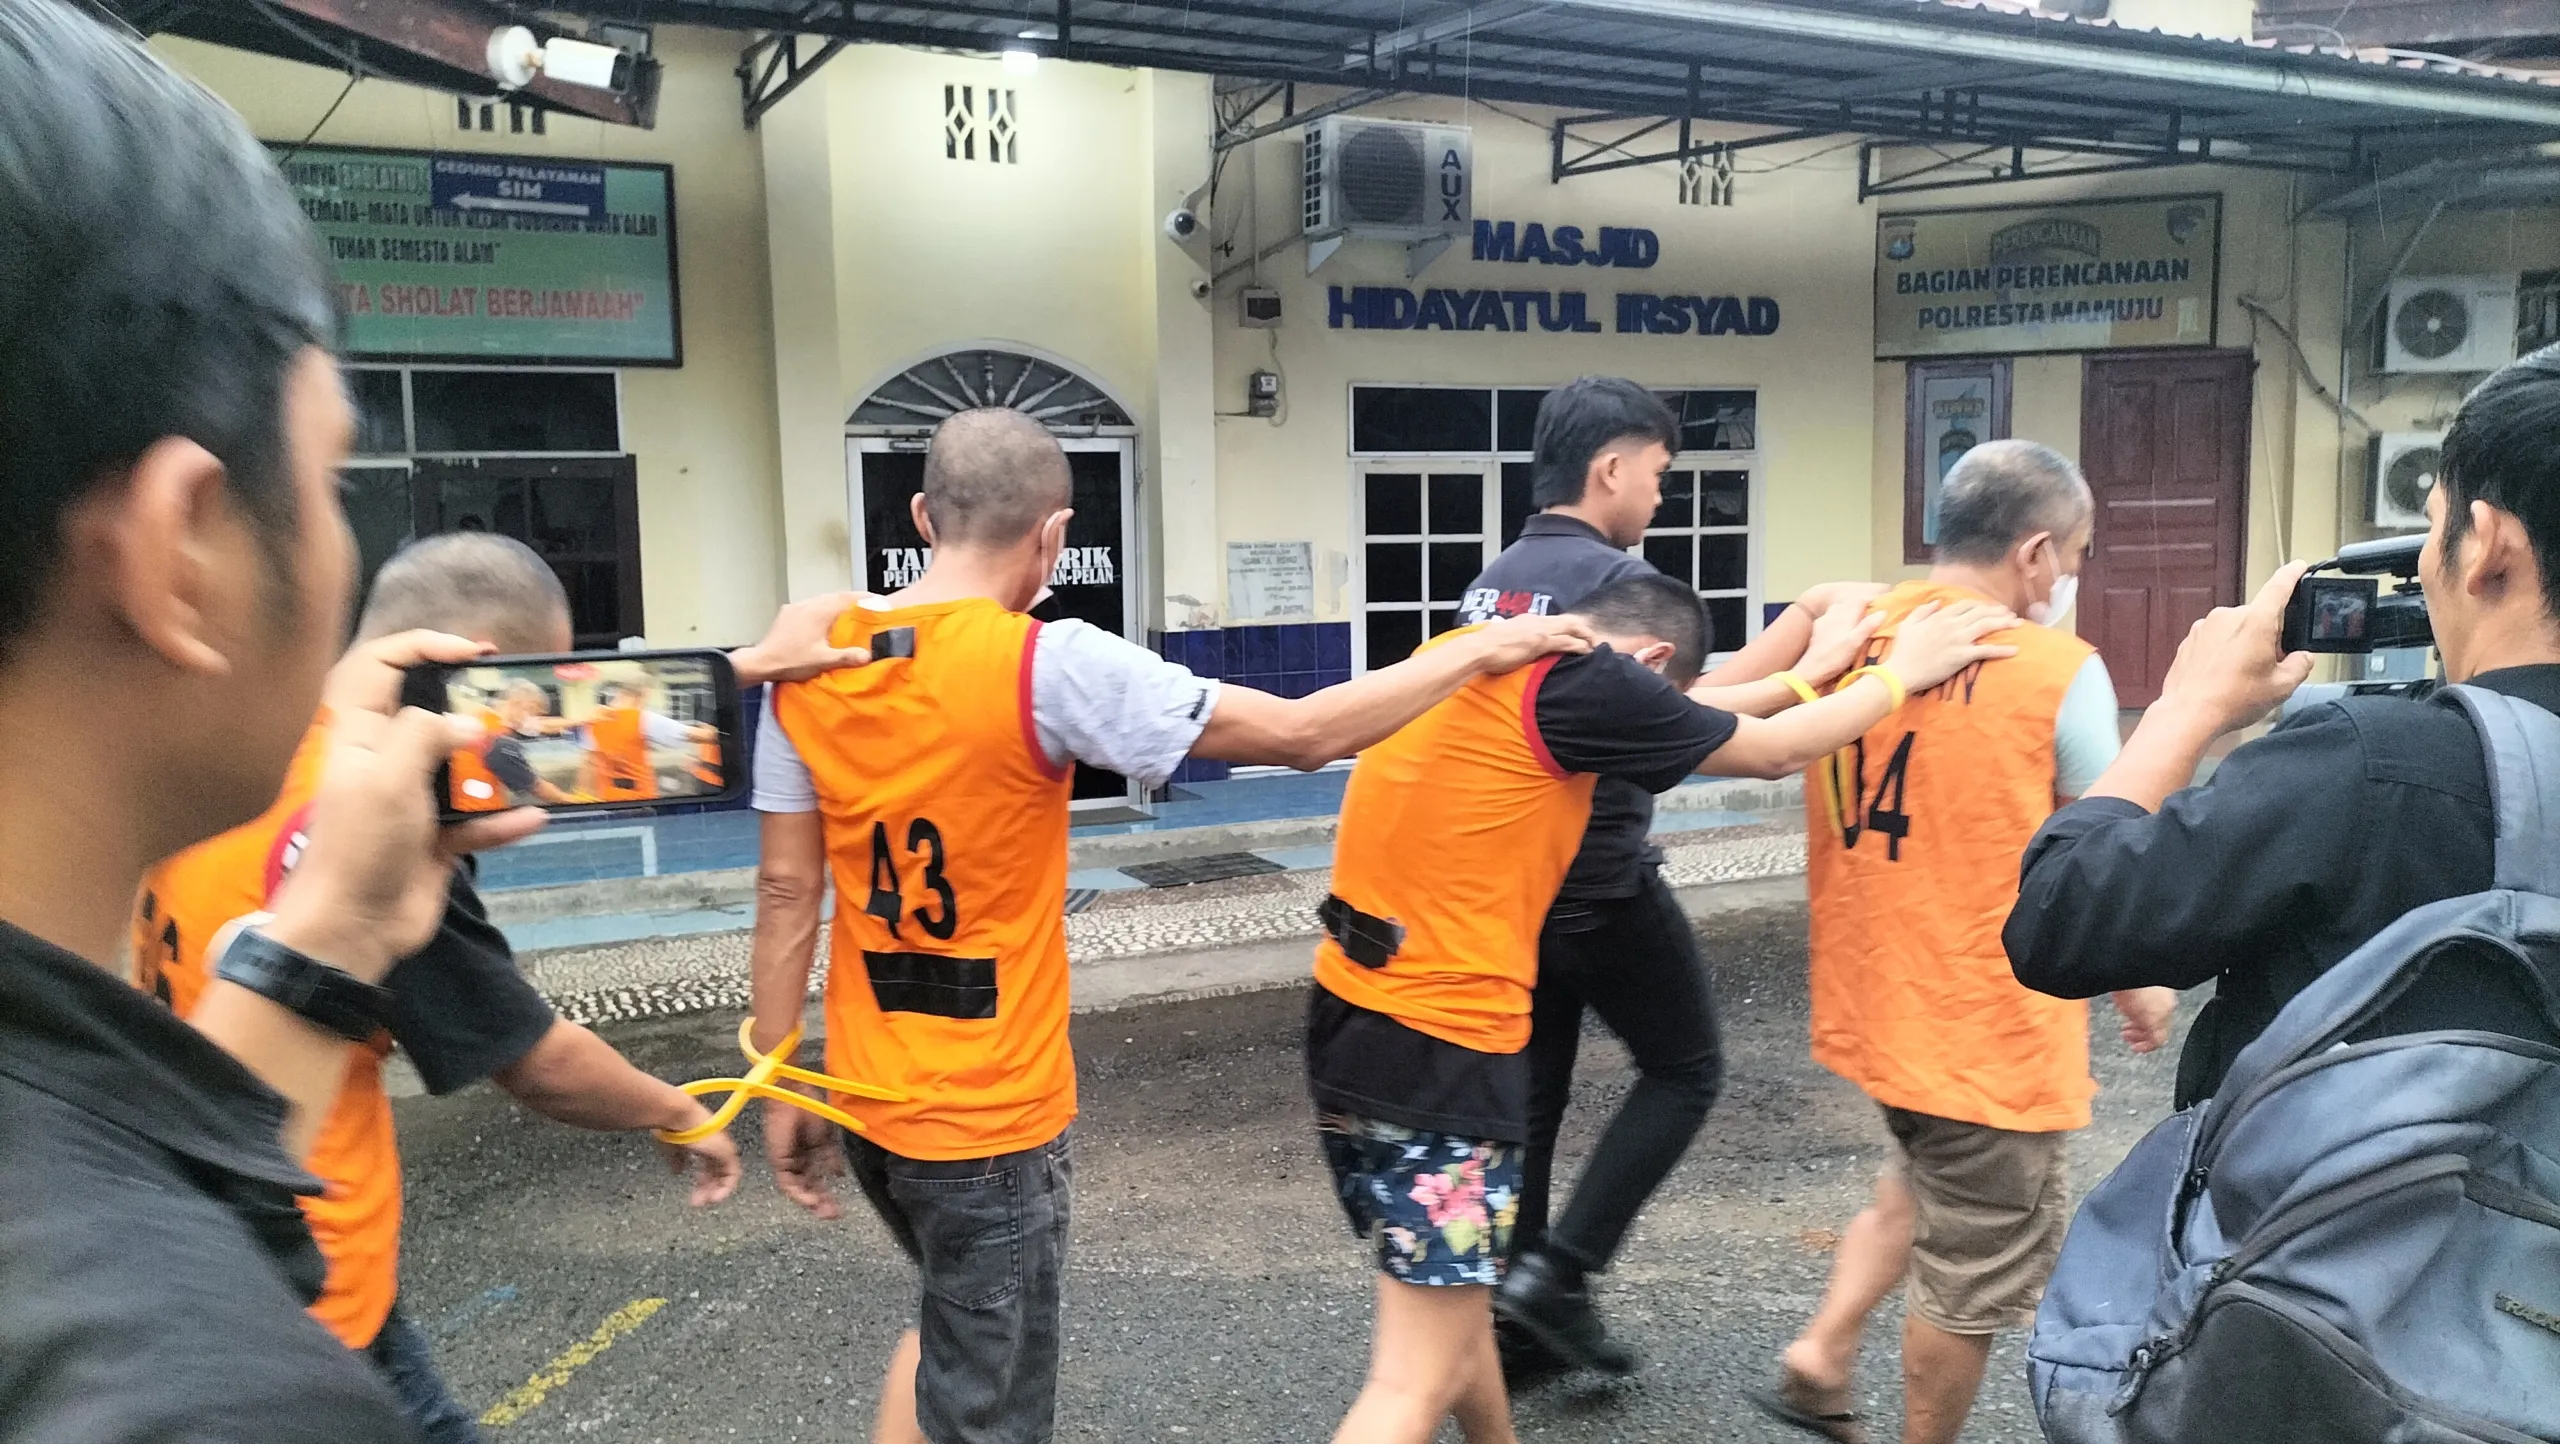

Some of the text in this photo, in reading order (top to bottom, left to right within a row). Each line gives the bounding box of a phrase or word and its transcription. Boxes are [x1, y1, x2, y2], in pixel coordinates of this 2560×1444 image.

[435, 160, 601, 185] GEDUNG PELAYANAN
[497, 180, 543, 199] SIM
[1441, 149, 1461, 220] AUX
[381, 237, 448, 262] SEMESTA
[1471, 219, 1660, 269] MASJID
[1896, 258, 2190, 295] BAGIAN PERENCANAAN
[380, 283, 478, 317] SHOLAT
[1327, 285, 1780, 337] HIDAYATUL IRSYAD
[1917, 296, 2163, 330] POLRESTA MAMUJU
[1053, 547, 1113, 569] RIK
[883, 570, 927, 588] PELA
[865, 817, 957, 941] 43
